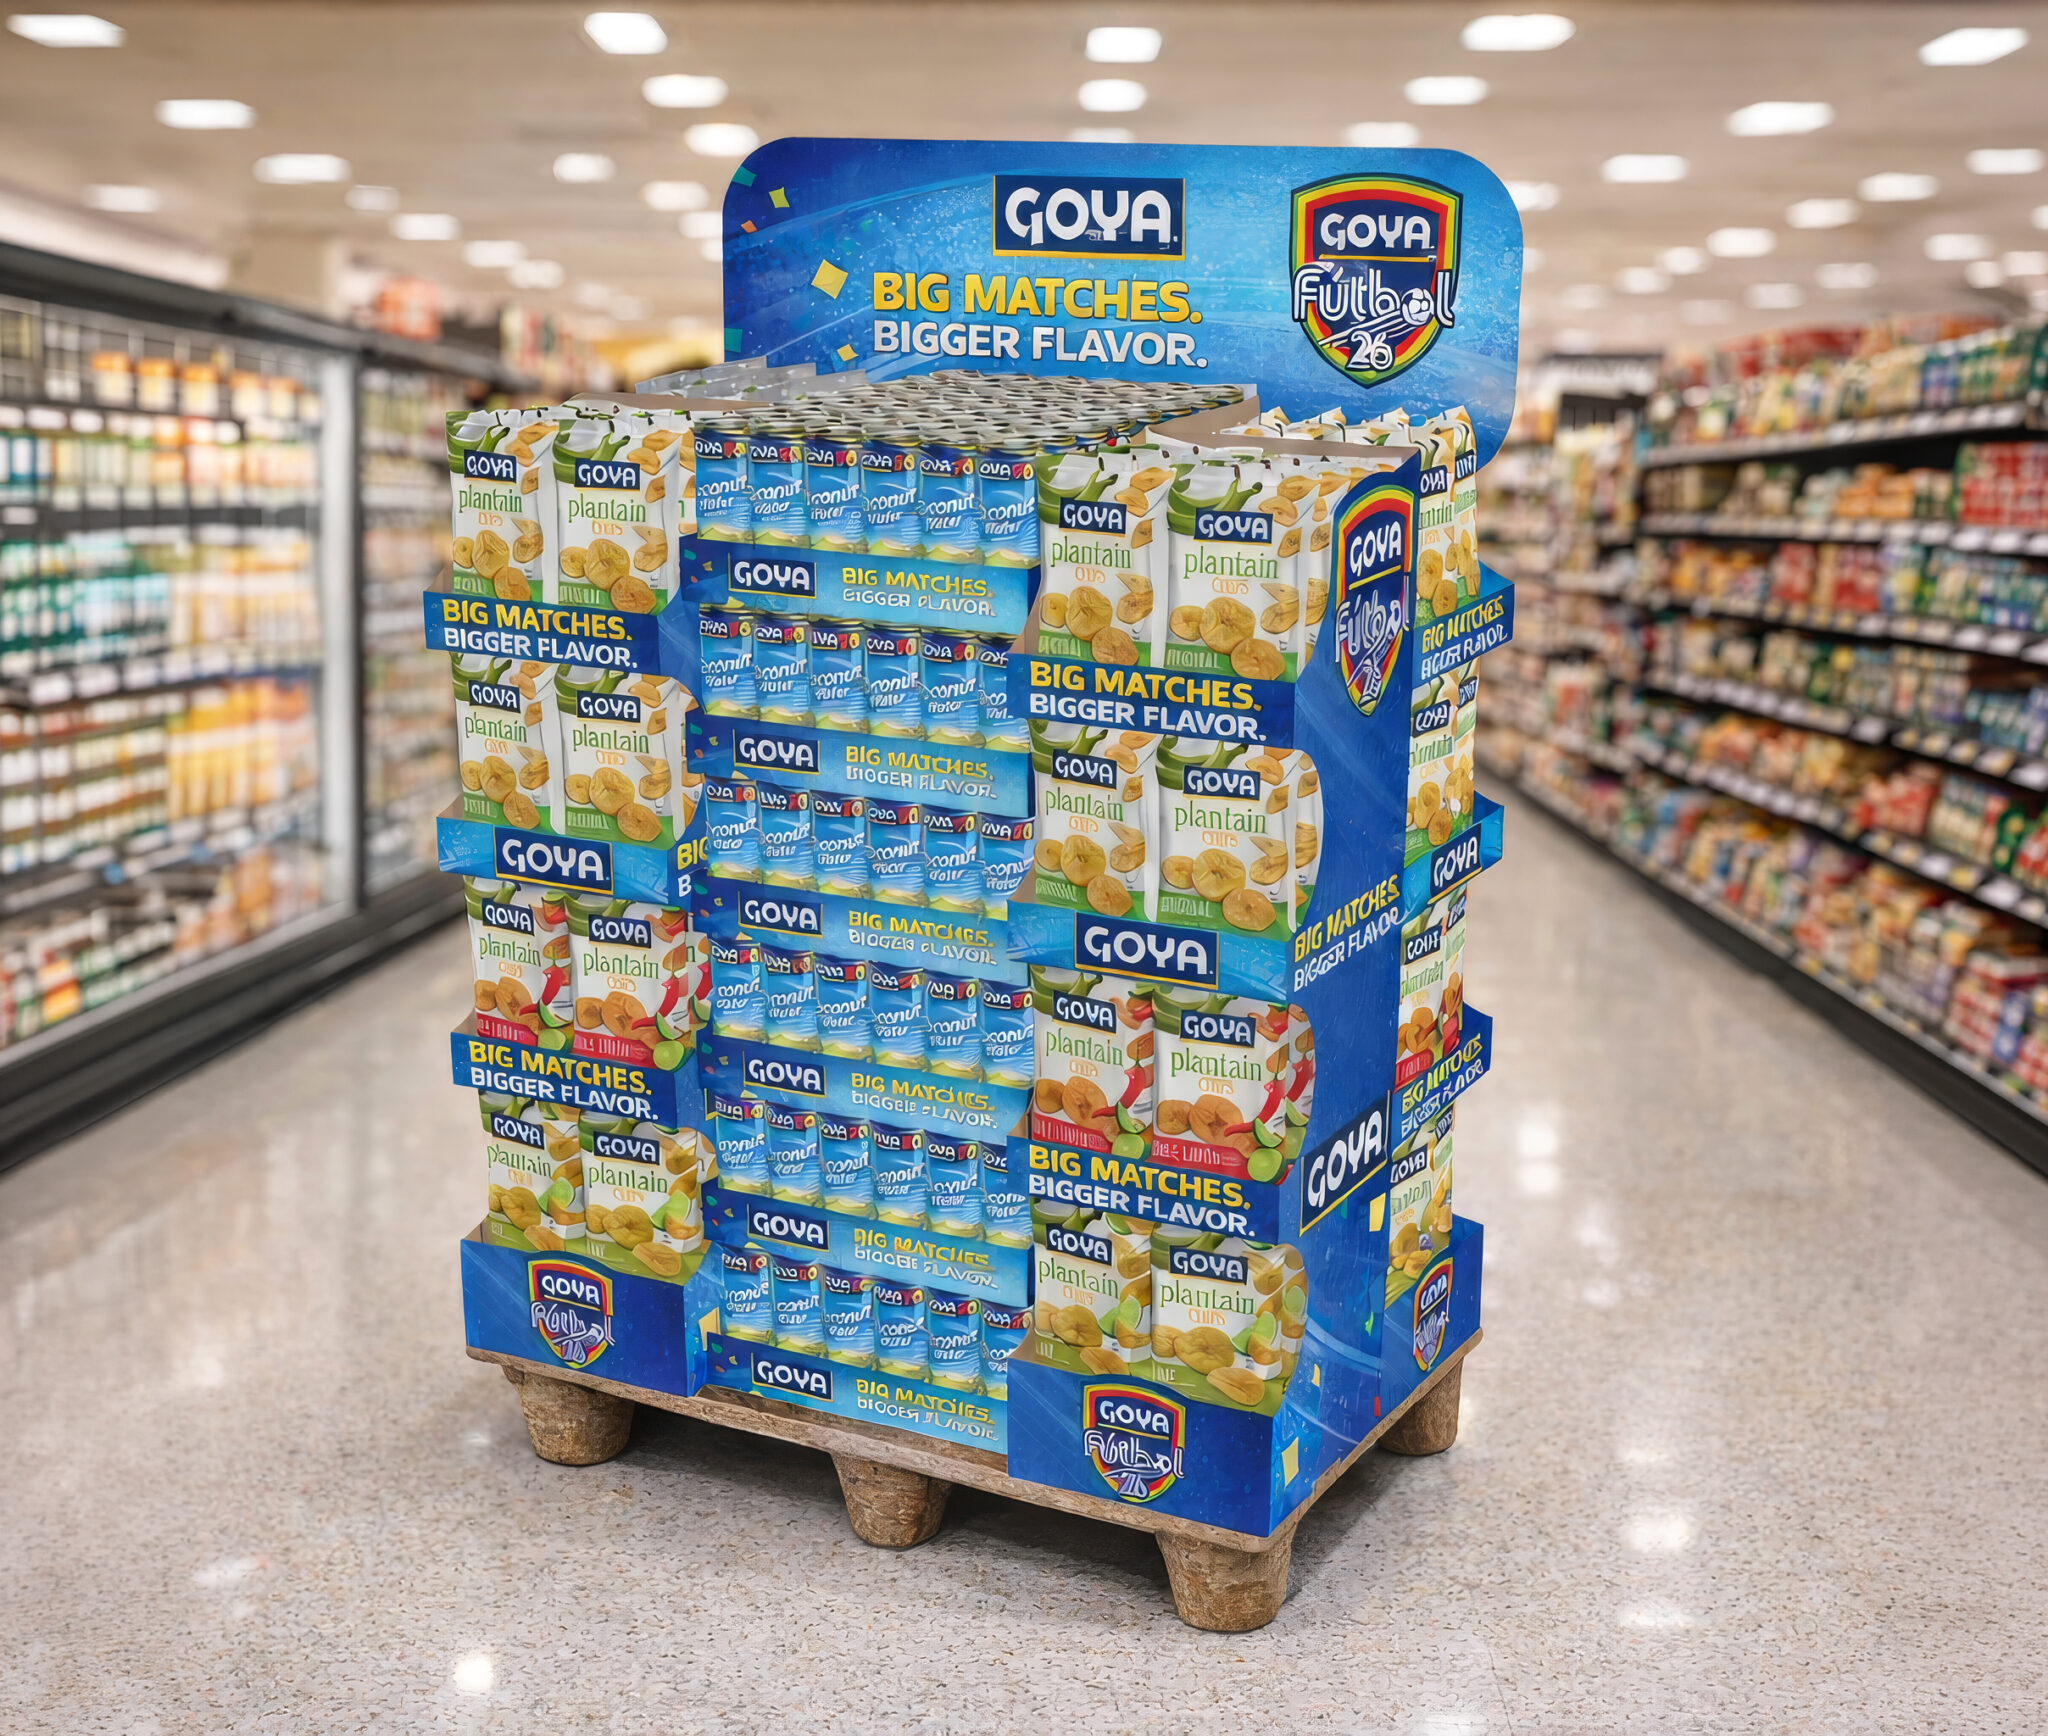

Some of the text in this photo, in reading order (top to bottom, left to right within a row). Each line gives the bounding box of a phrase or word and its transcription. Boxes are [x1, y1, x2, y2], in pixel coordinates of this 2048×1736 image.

[1005, 187, 1171, 245] GOYA
[1320, 213, 1431, 250] GOYA
[873, 272, 1202, 324] BIG MATCHES.
[873, 320, 1208, 368] BIGGER FLAVOR.
[1346, 330, 1394, 370] 26
[1051, 536, 1131, 569] plantain
[1183, 546, 1279, 579] plantain
[1350, 521, 1401, 576] GOYA
[734, 561, 810, 590] GOYA
[442, 599, 633, 640] BIG MATCHES.
[444, 628, 638, 668] BIGGER FLAVOR.
[1030, 660, 1262, 711] BIG MATCHES.
[1029, 693, 1267, 741] BIGGER FLAVOR.
[739, 737, 814, 767] GOYA
[846, 746, 881, 763] BIG
[1175, 801, 1267, 834] plantain
[502, 839, 604, 880] GOYA
[744, 899, 818, 930] GOYA
[1084, 926, 1208, 975] GOYA
[1295, 919, 1321, 962] BIG
[1046, 1028, 1123, 1067] plantain
[1171, 1048, 1262, 1081] plantain
[469, 1041, 652, 1095] BIG MATCHES.
[748, 1059, 822, 1091] GOYA
[470, 1067, 658, 1120] BIGGER FLAVOR.
[1029, 1144, 1251, 1210] BIG MATCHES.
[1307, 1109, 1384, 1209] GOYA
[1029, 1175, 1255, 1237] BIGGER FLAVOR.
[1039, 1257, 1119, 1299] plantain
[1160, 1283, 1254, 1315] plantain
[757, 1361, 826, 1394] GOYA
[1099, 1400, 1170, 1433] GOYA
